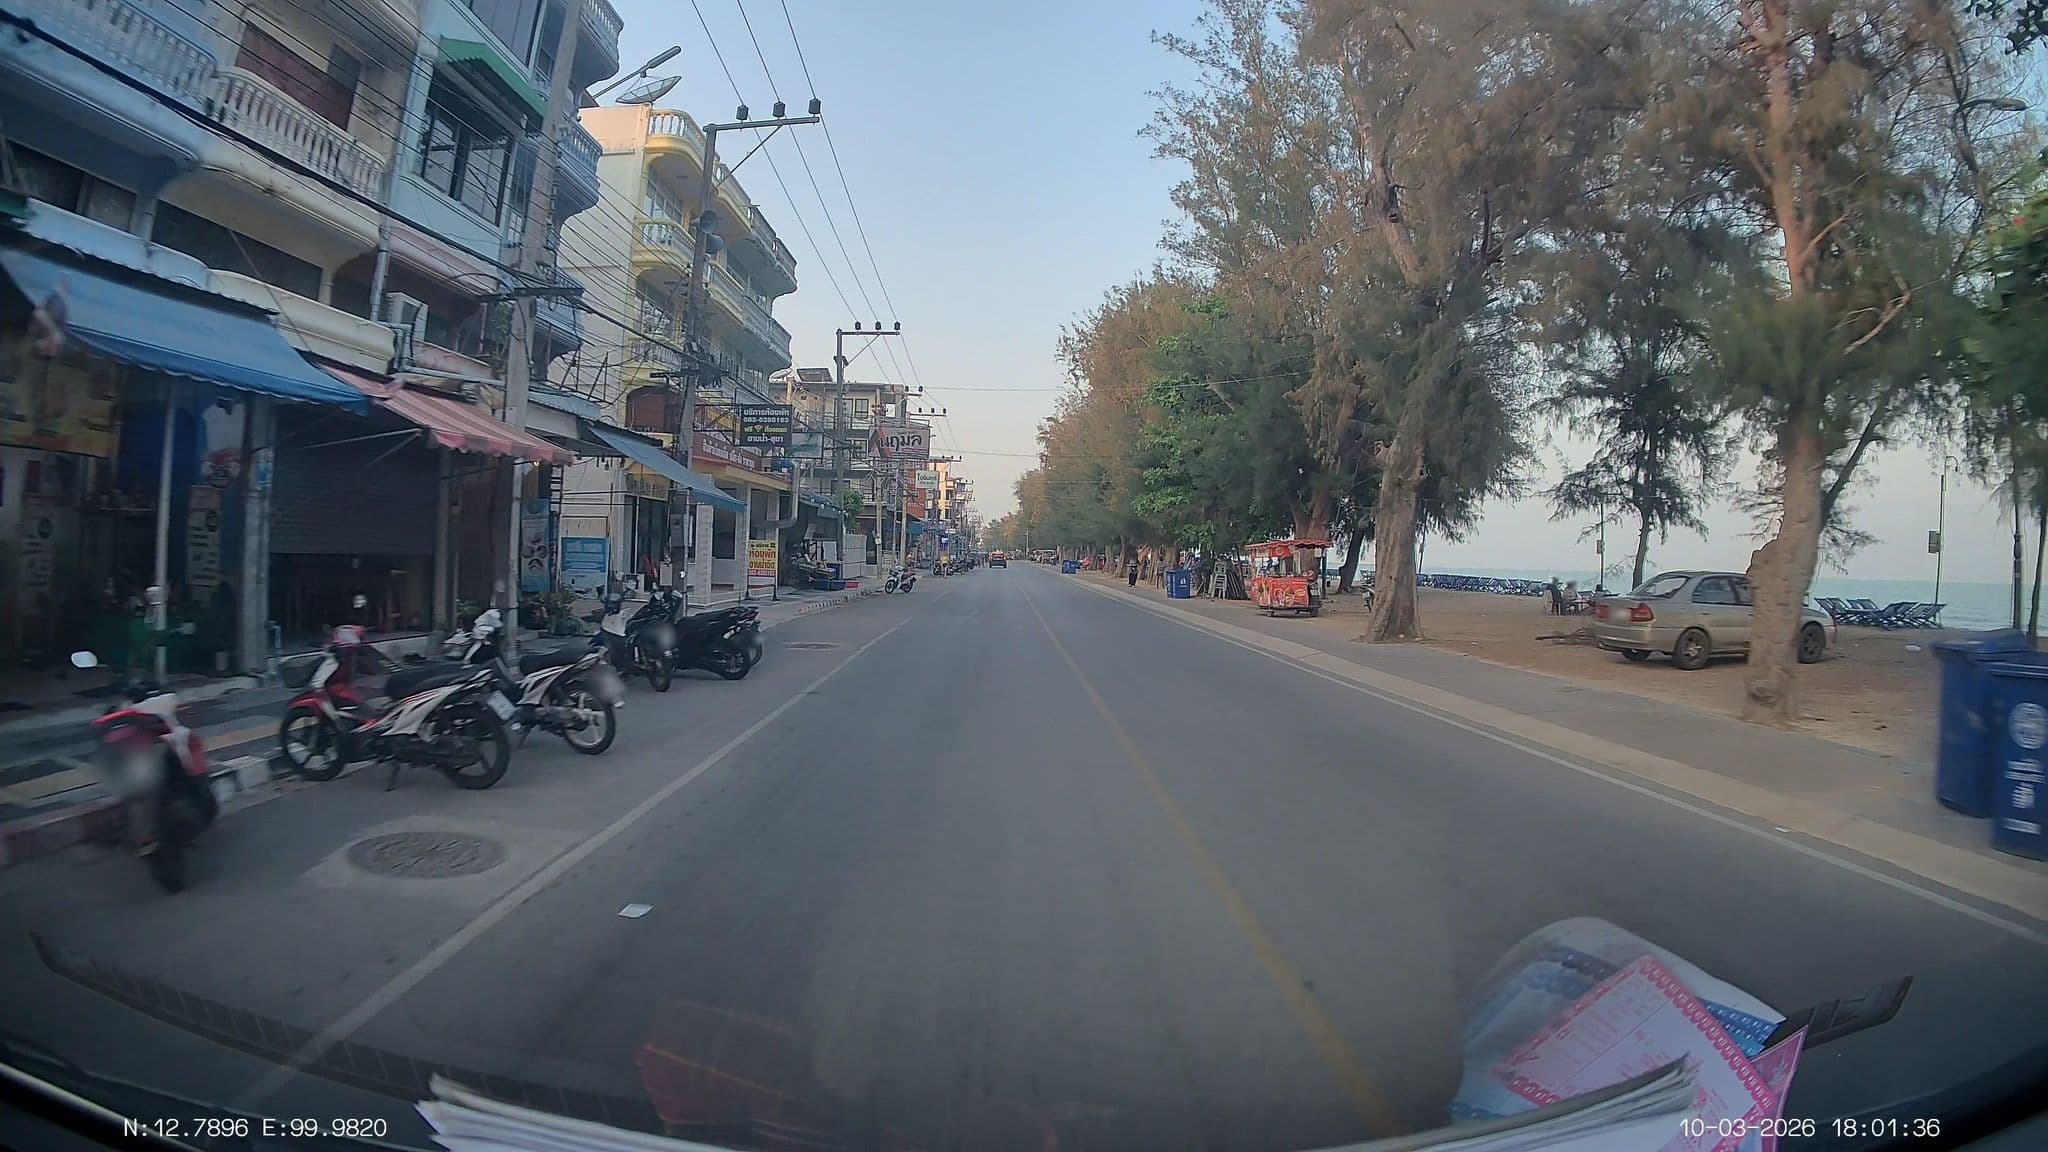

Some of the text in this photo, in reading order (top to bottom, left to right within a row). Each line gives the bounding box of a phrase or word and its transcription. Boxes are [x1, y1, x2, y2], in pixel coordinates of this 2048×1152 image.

[880, 434, 922, 452] นฤมล
[749, 548, 776, 558] ห้องพัก
